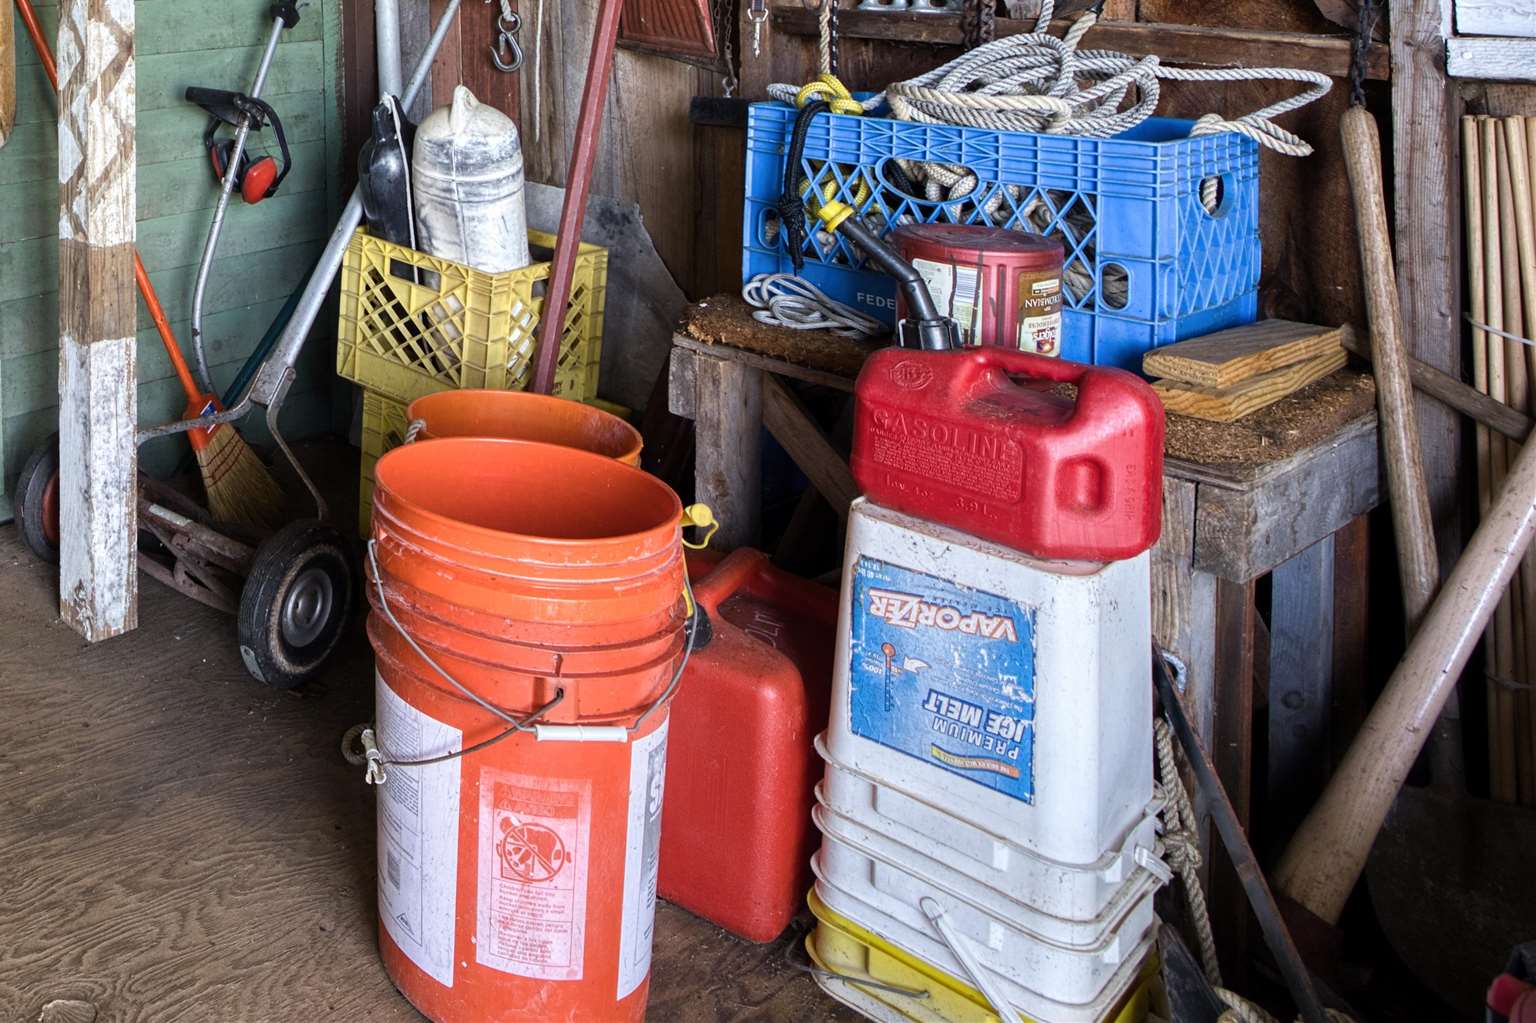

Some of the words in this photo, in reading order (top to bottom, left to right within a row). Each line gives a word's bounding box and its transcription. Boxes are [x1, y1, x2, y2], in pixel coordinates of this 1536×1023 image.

[856, 292, 895, 310] FEDE
[868, 588, 1018, 642] VAPORIZER
[924, 690, 983, 728] MELT
[985, 710, 1026, 744] ICE
[932, 716, 1020, 760] PREMIUM
